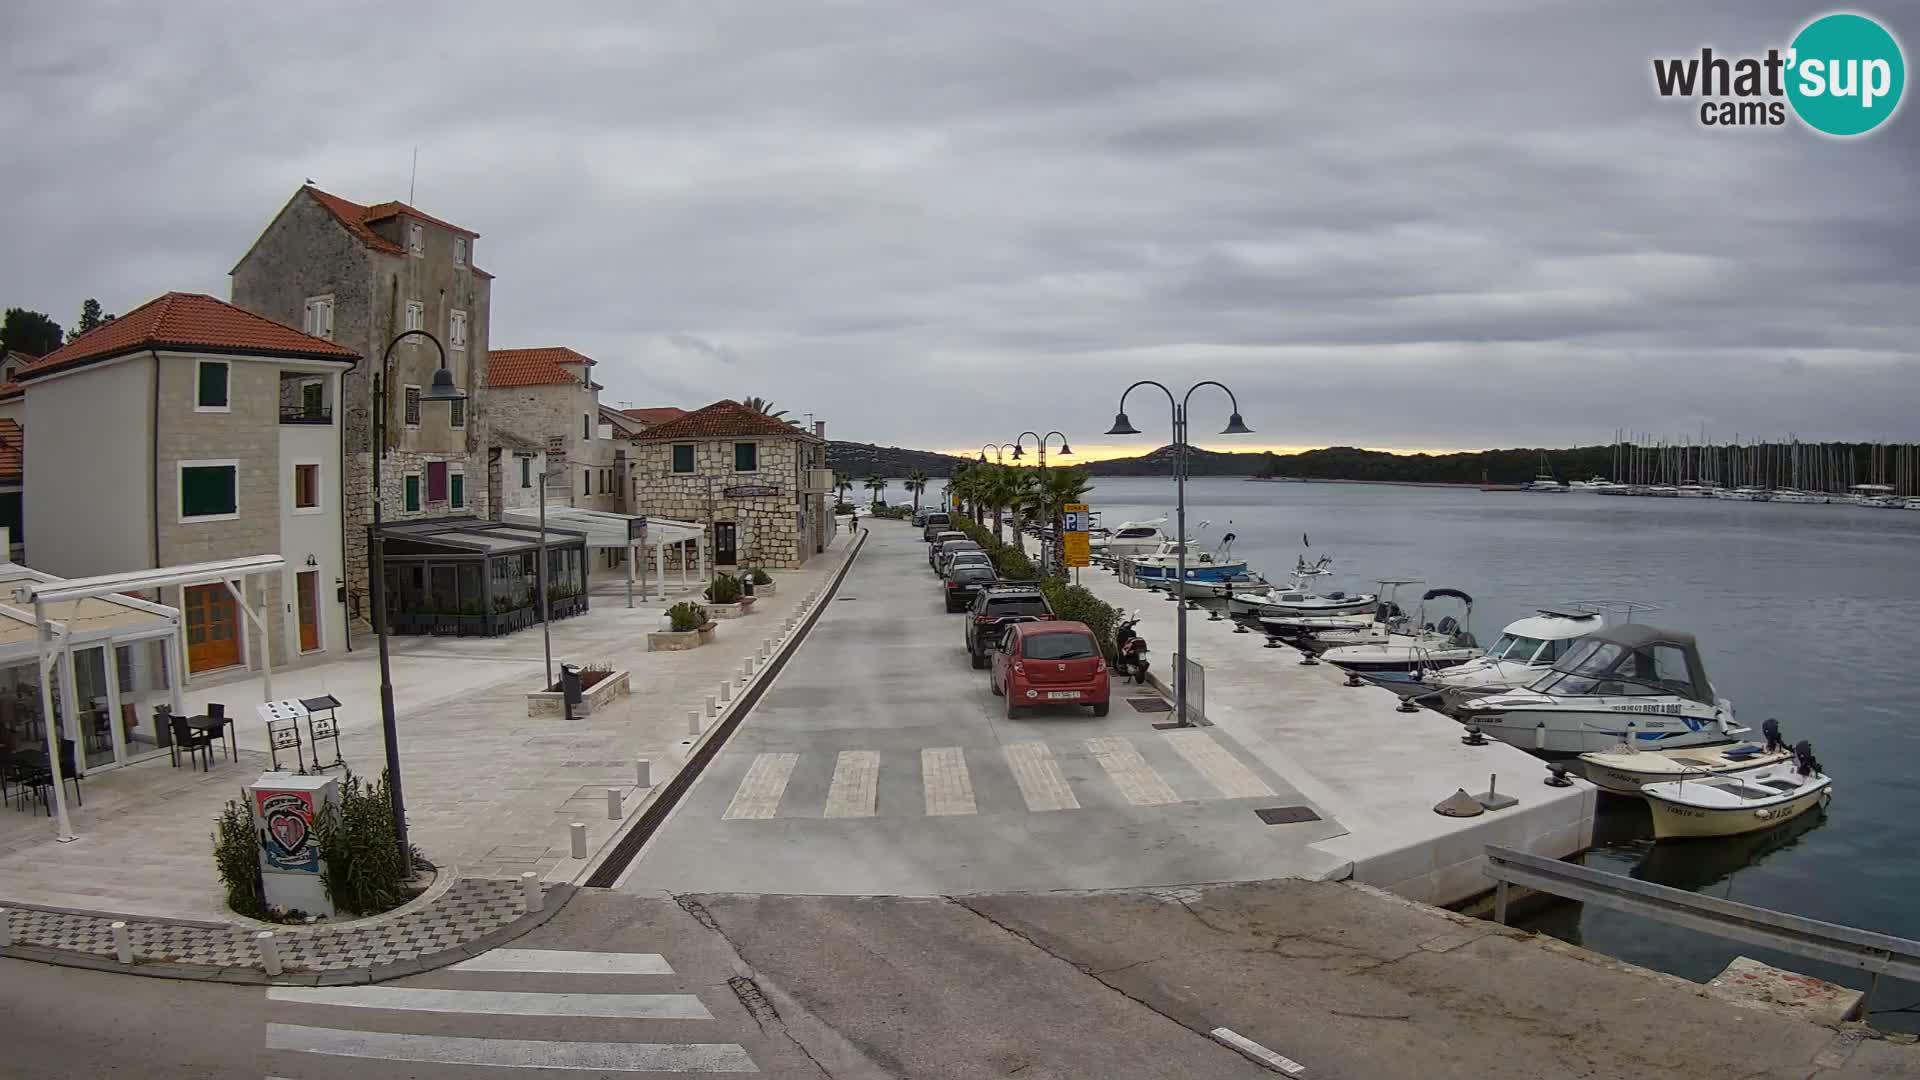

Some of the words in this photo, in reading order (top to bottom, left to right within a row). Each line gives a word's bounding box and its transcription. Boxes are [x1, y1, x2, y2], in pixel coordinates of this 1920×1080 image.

[1066, 513, 1077, 530] P
[1643, 704, 1660, 713] RENT
[1661, 704, 1665, 713] A
[1666, 703, 1682, 714] BOAT
